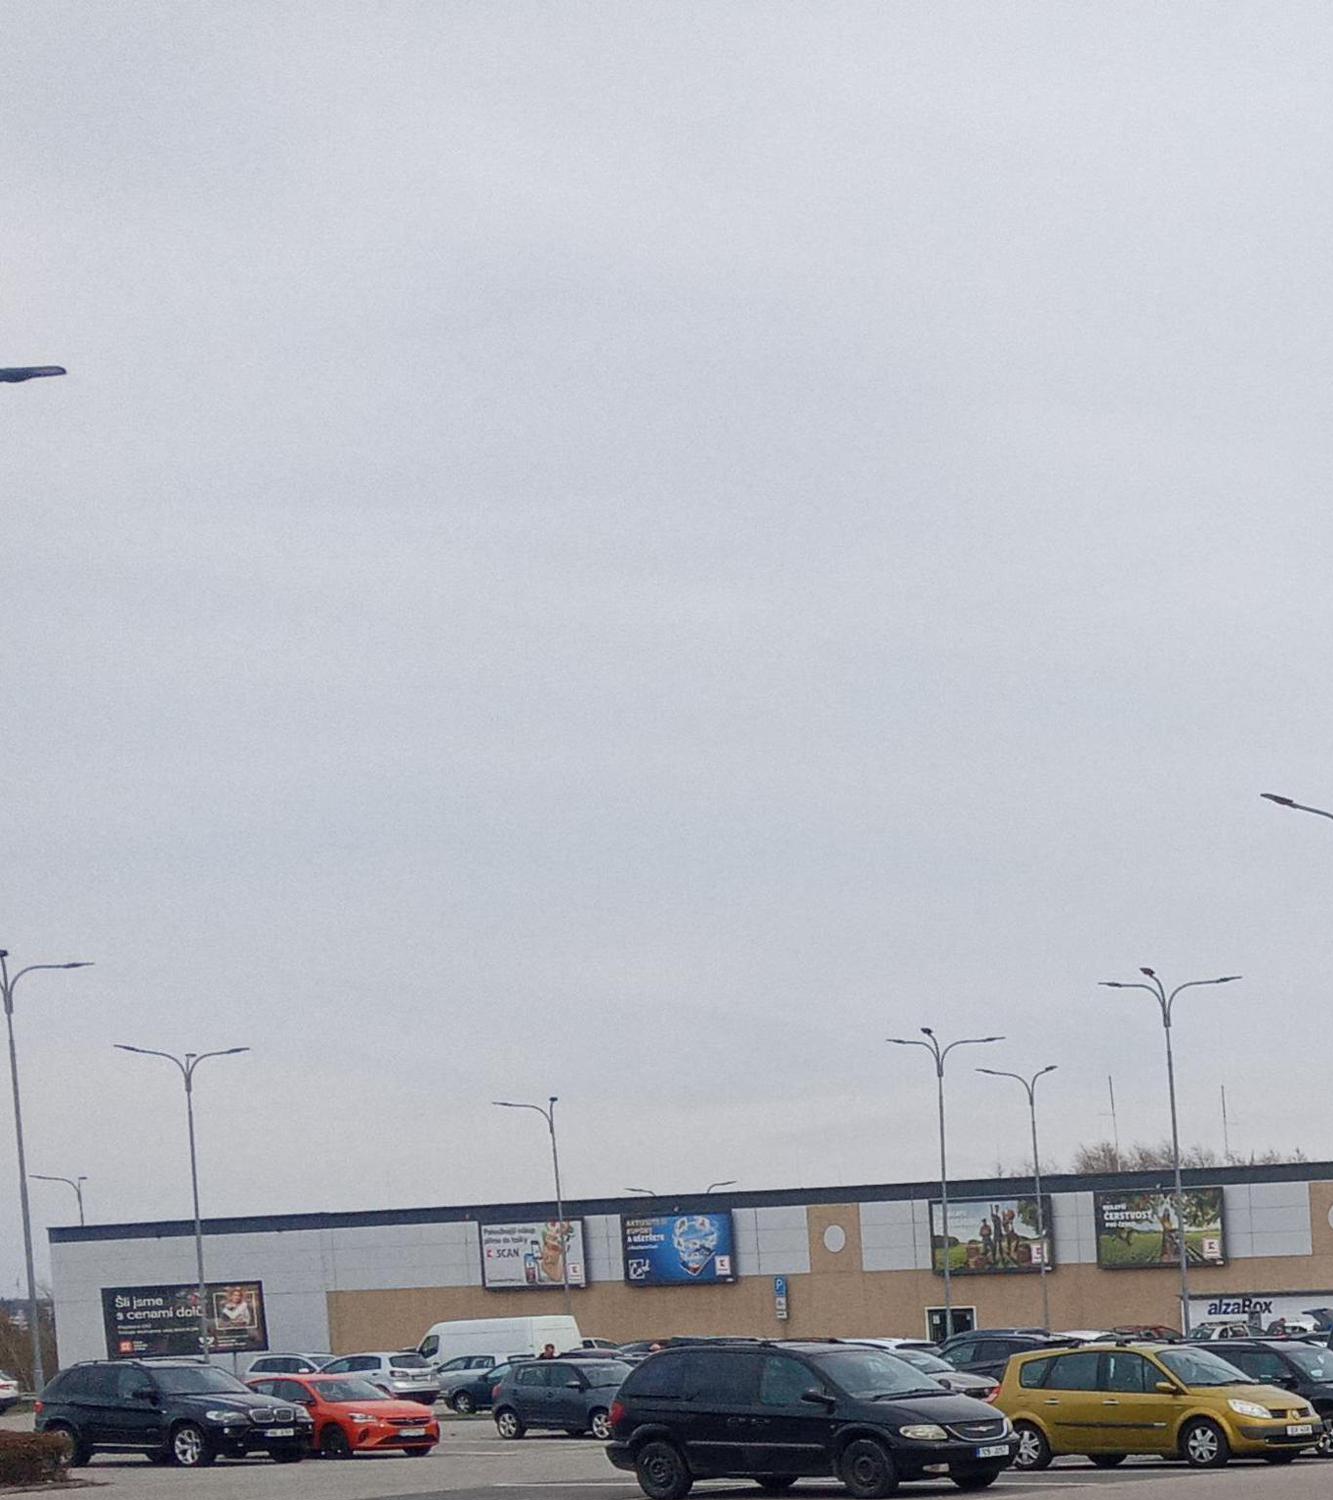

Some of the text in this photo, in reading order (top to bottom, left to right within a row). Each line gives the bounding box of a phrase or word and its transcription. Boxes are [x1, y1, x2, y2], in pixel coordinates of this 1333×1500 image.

[496, 1248, 519, 1258] SCAN
[115, 1295, 163, 1309] Šli jsme
[1208, 1299, 1273, 1315] alzaBox
[126, 1307, 173, 1320] cenami
